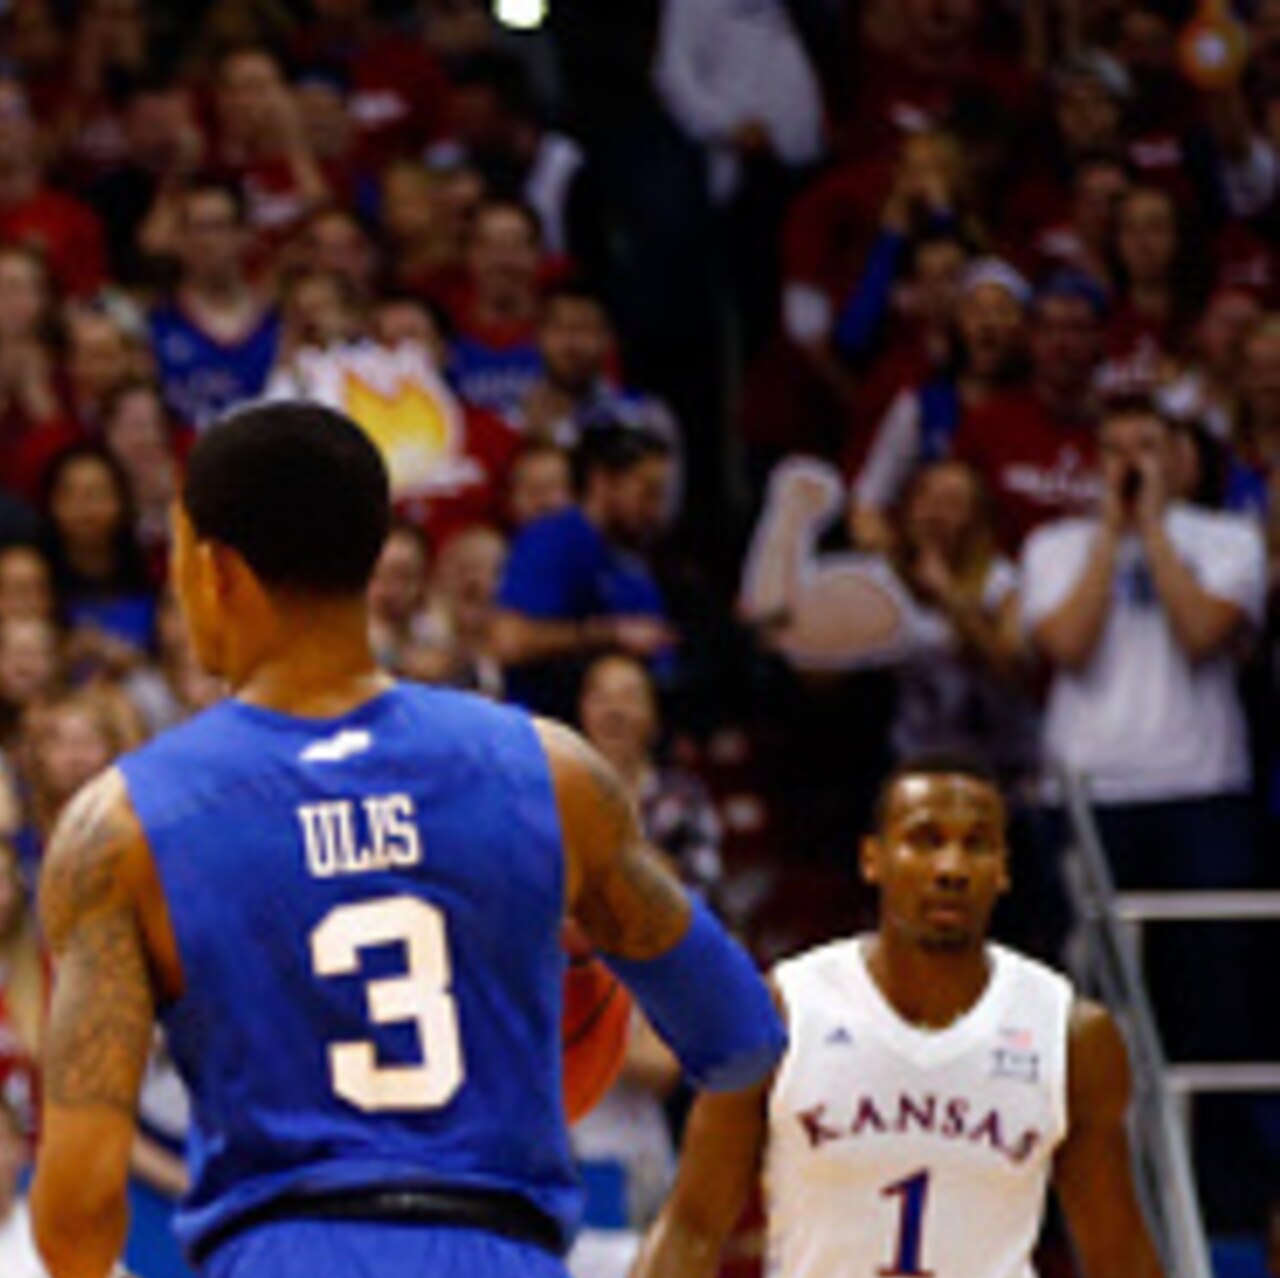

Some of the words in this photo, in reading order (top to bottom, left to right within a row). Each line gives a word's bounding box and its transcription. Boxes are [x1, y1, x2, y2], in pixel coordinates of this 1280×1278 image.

[297, 793, 423, 877] ULIS
[309, 894, 466, 1112] 3
[797, 1090, 1040, 1165] KANSAS
